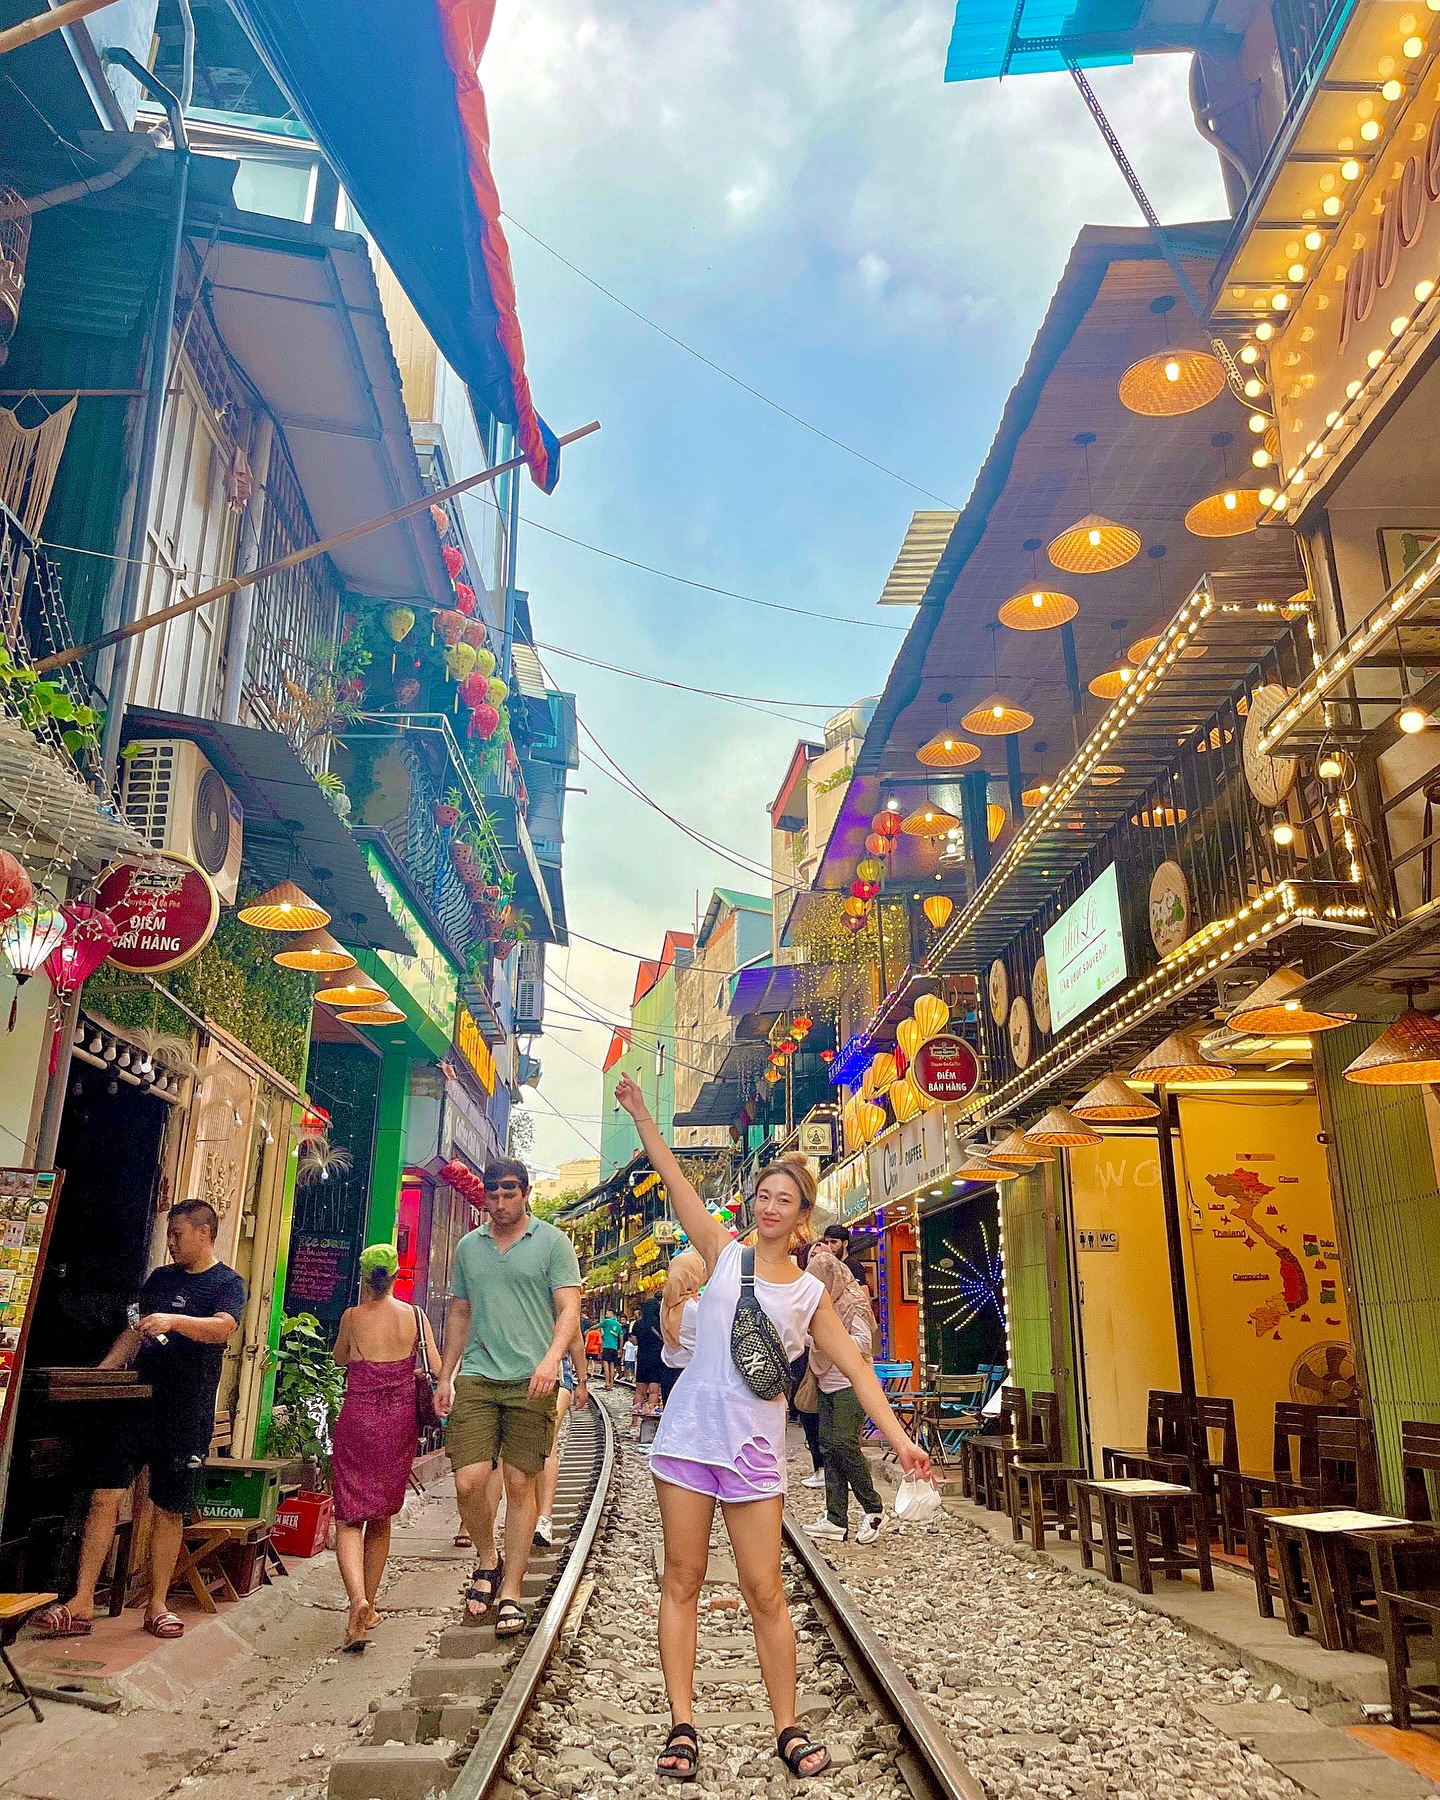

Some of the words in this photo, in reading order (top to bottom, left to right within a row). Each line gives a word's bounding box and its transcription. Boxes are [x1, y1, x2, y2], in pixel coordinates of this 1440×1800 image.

[140, 933, 181, 951] HÀNG
[1082, 943, 1107, 975] souvenir
[928, 1081, 944, 1092] BÁN
[945, 1081, 967, 1092] HÀNG
[904, 1143, 923, 1167] COFFEE
[1099, 1233, 1117, 1243] WC
[1212, 1228, 1246, 1238] Thailand
[202, 1506, 244, 1518] SAIGON
[283, 1515, 302, 1530] BEER
